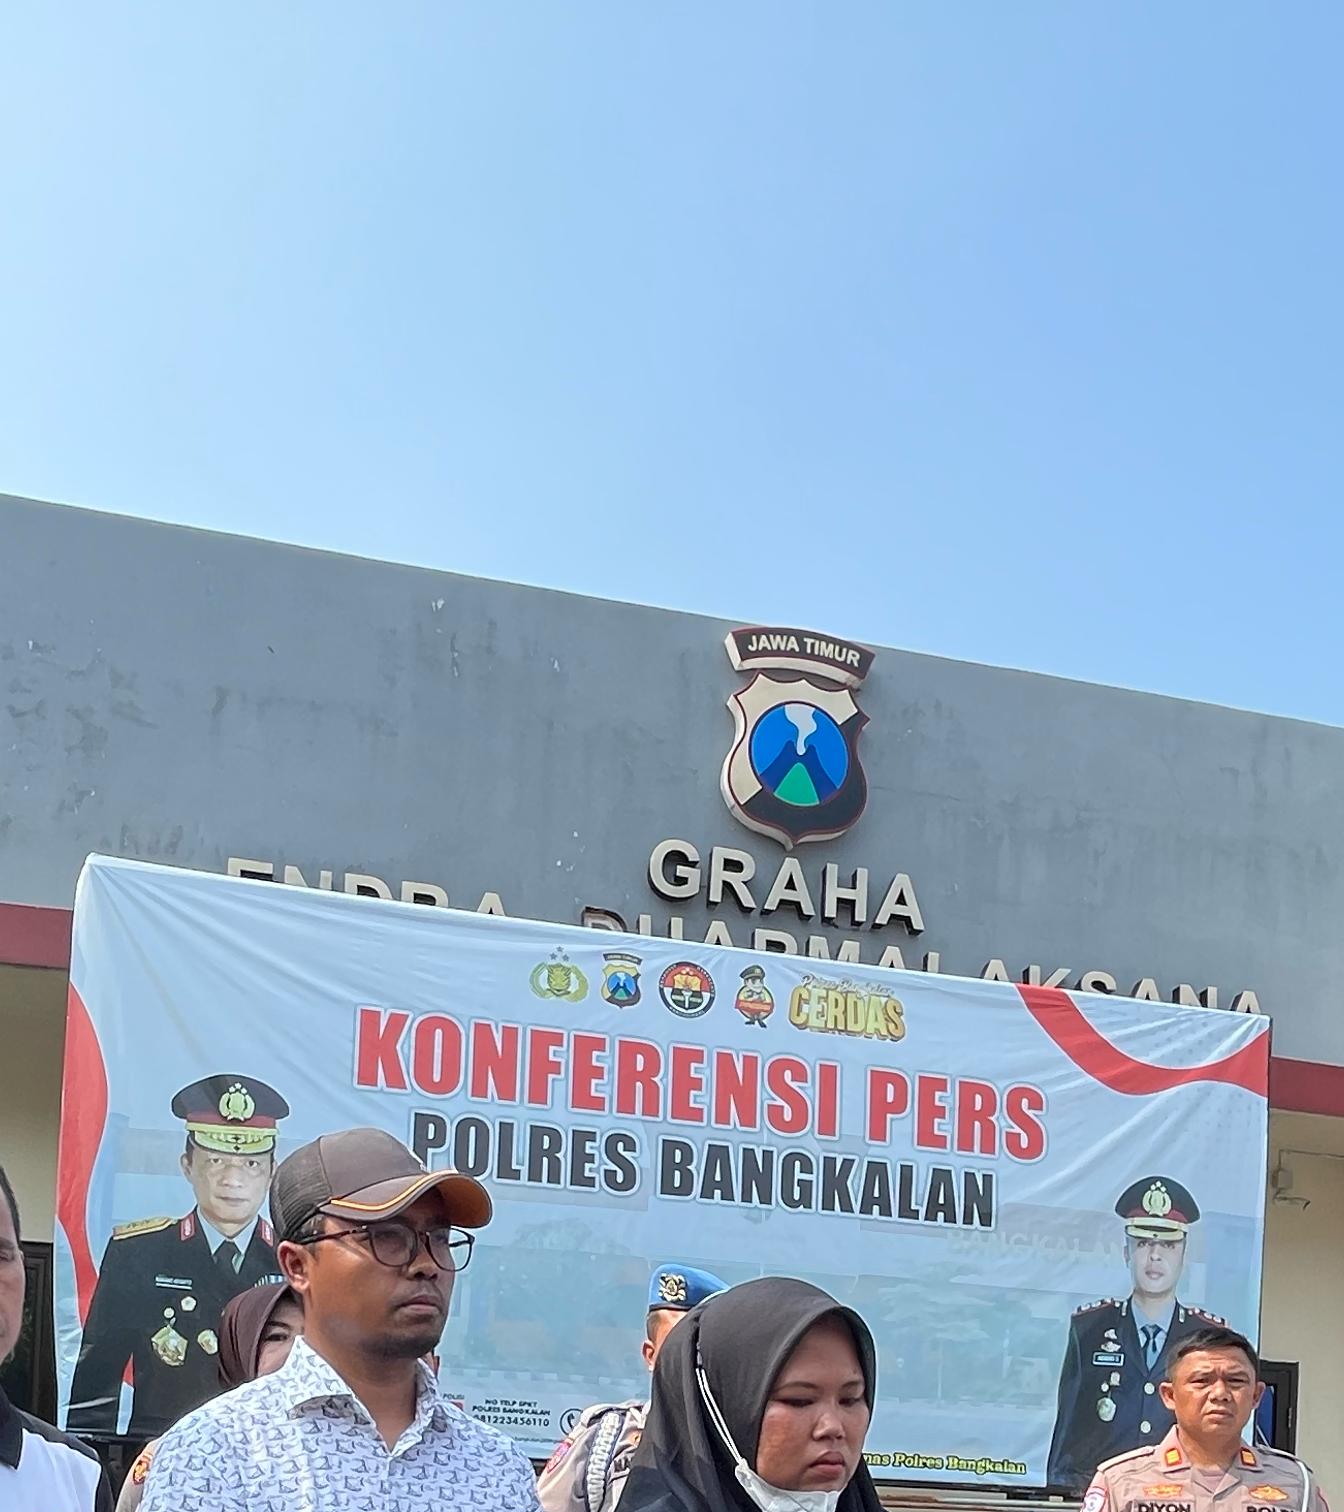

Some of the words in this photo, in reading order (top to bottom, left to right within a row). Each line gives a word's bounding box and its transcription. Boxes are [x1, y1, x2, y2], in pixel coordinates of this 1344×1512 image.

[748, 634, 800, 652] JAWA
[803, 637, 861, 667] TIMUR
[649, 838, 923, 932] GRAHA
[790, 984, 906, 1041] CERDAS
[356, 1009, 839, 1139] KONFERENSI
[867, 1067, 1047, 1161] PERS
[414, 1112, 638, 1192] POLRES
[660, 1138, 995, 1228] BANGKALAN
[472, 1405, 501, 1413] POLRES
[893, 1452, 943, 1469] Polres
[946, 1455, 1027, 1475] Bangkalan
